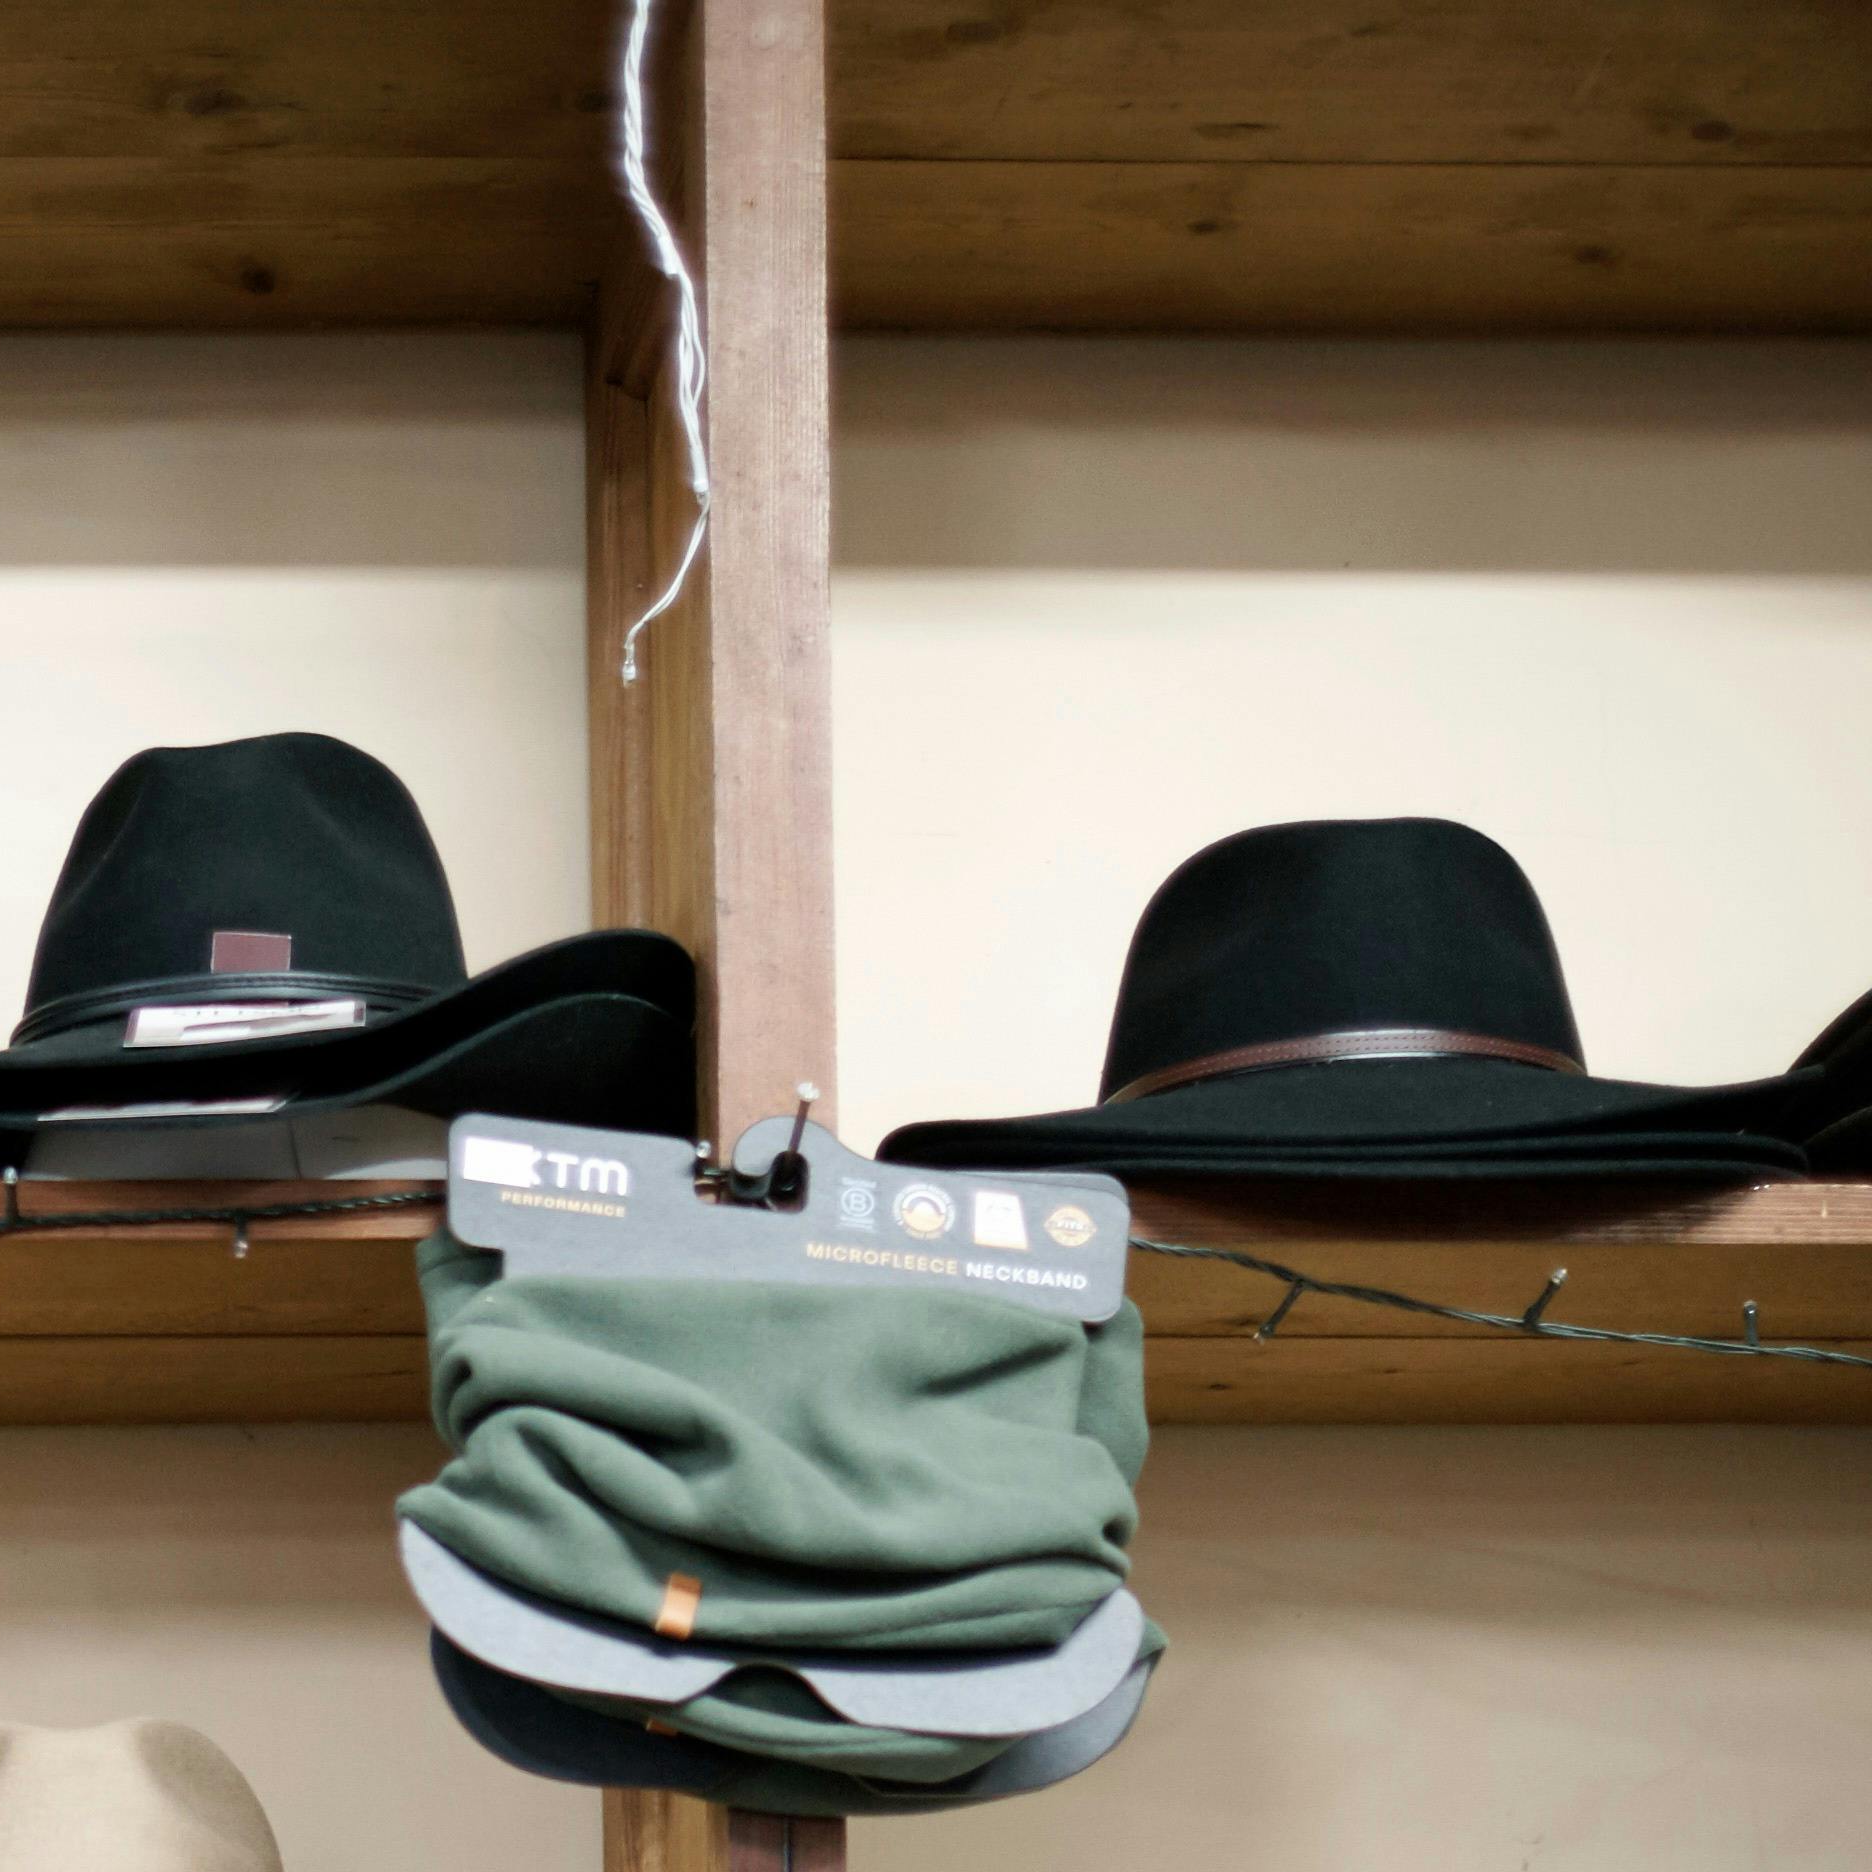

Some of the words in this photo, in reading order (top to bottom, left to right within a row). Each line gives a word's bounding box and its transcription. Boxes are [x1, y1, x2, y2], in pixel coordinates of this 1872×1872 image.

[500, 1190, 626, 1218] PERFORMANCE
[805, 1243, 959, 1276] MICROFLEECE
[965, 1261, 1088, 1290] NECKBAND
